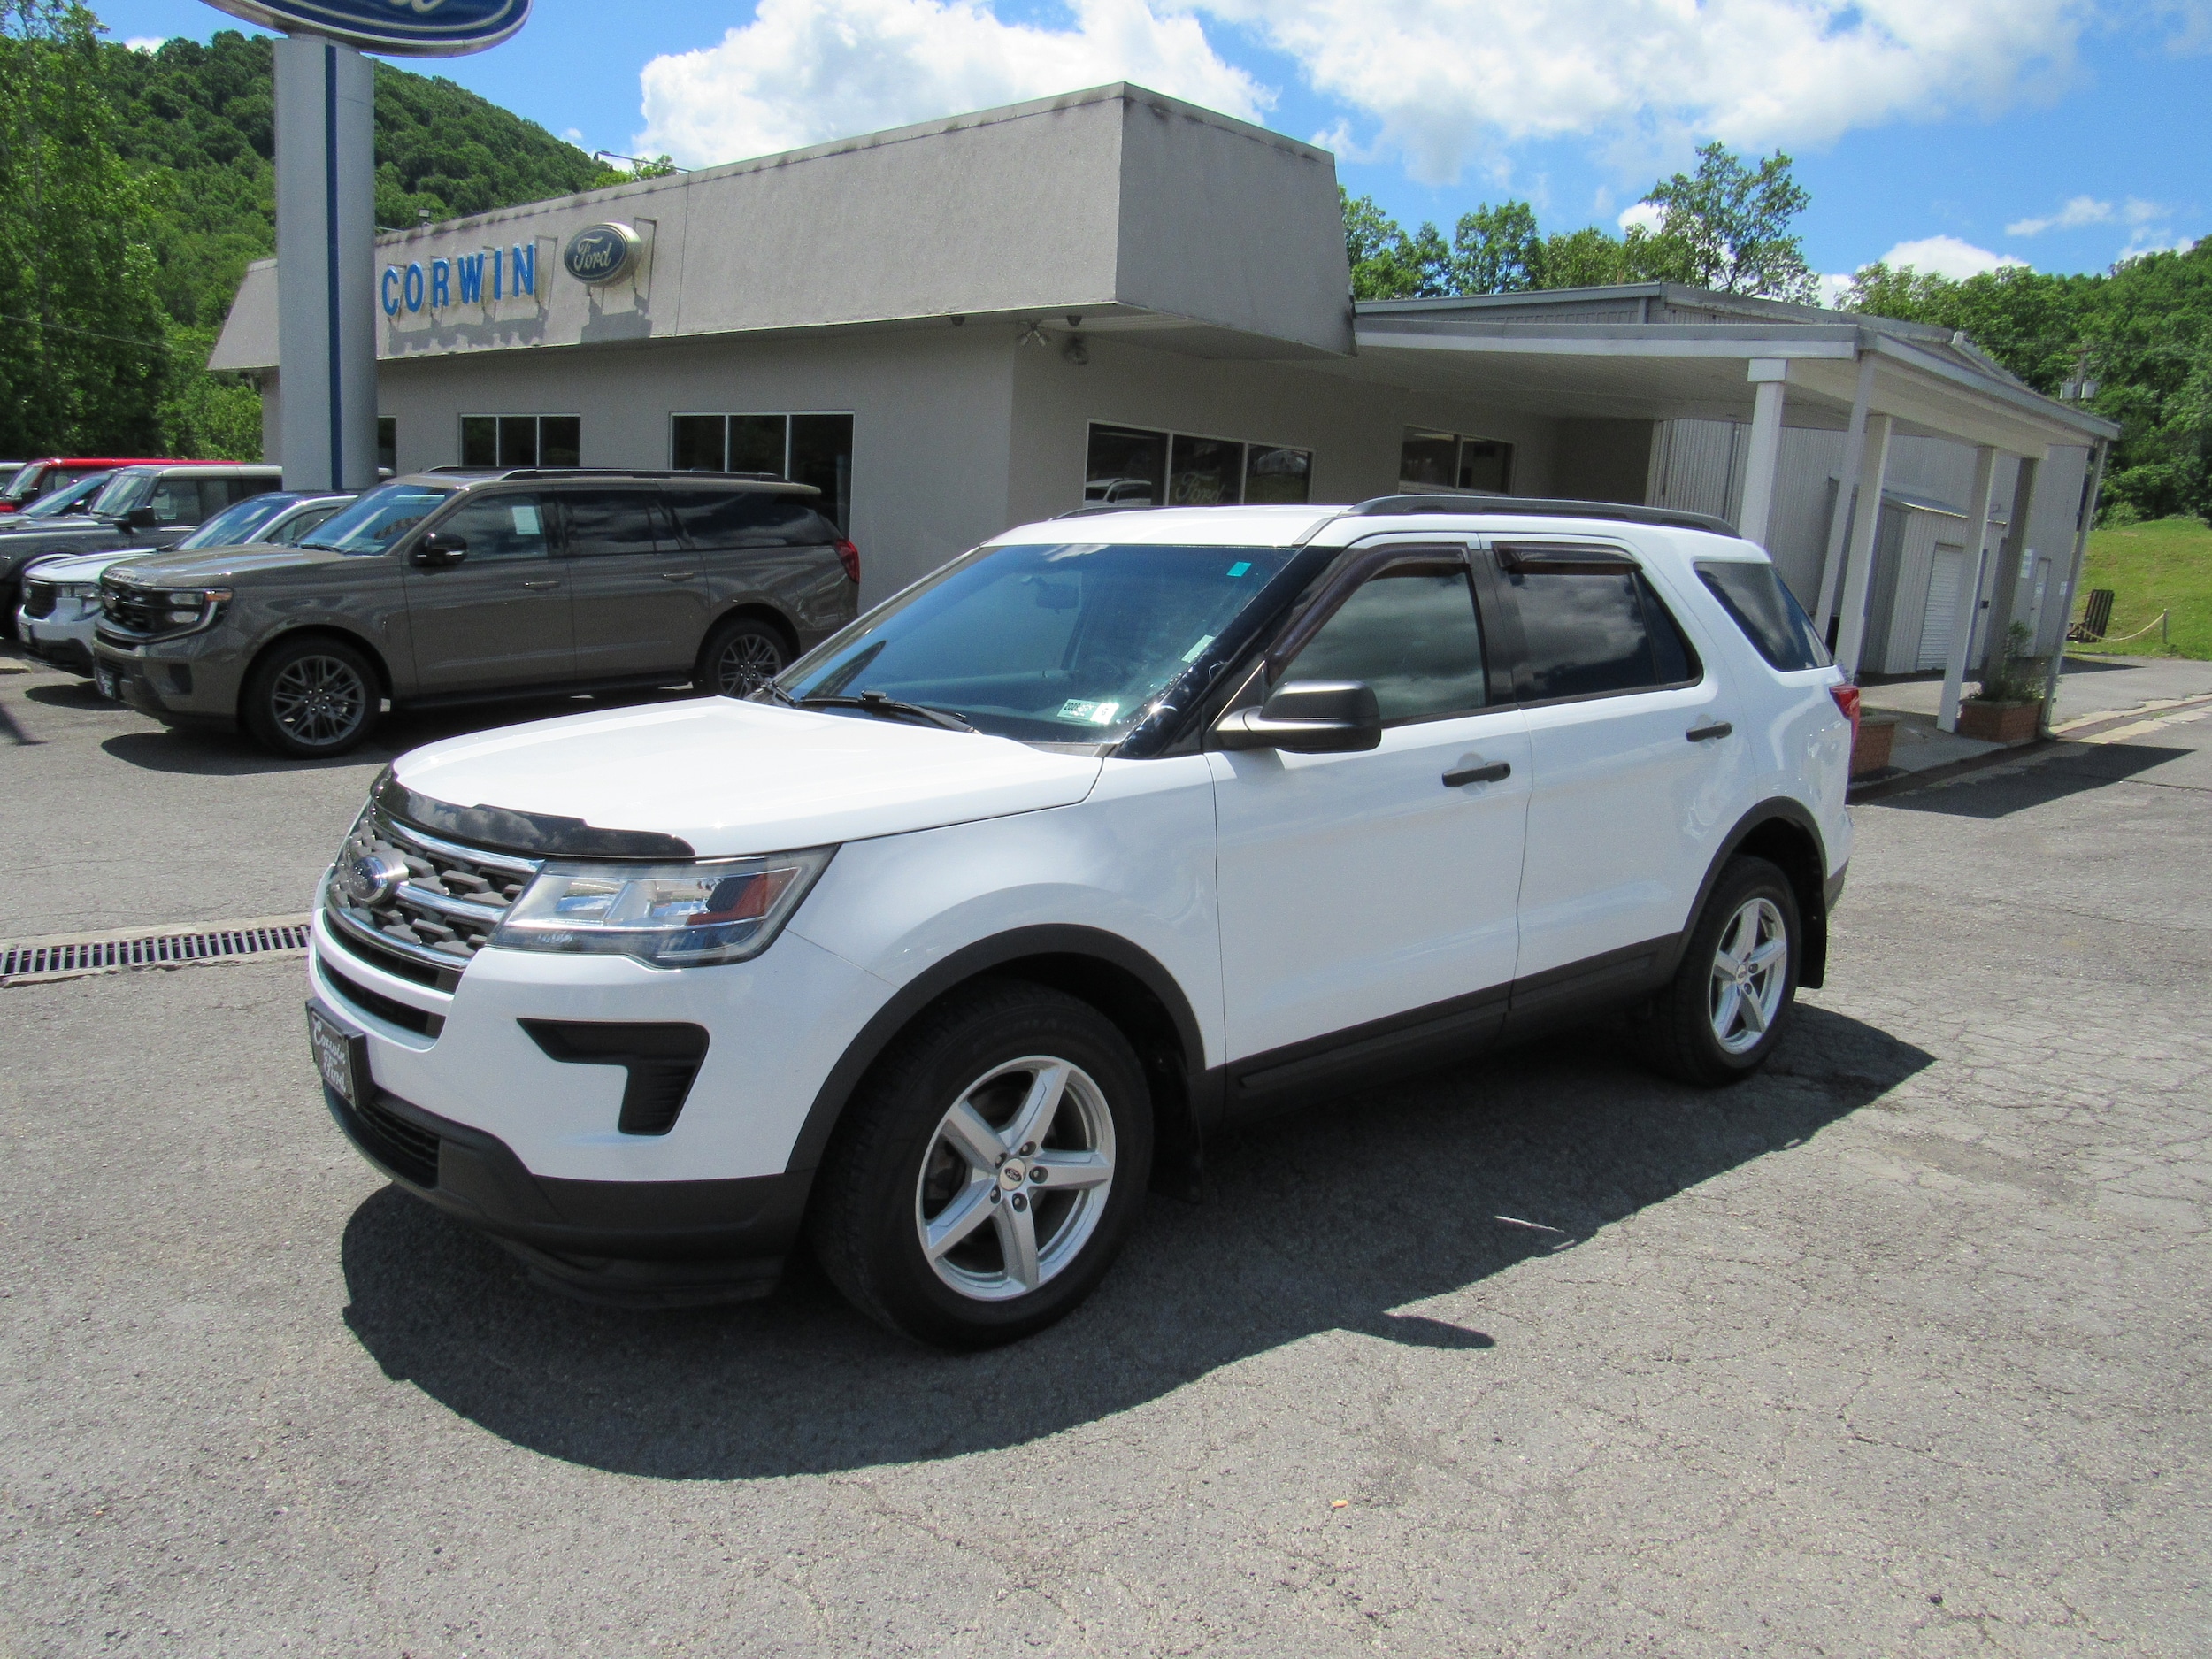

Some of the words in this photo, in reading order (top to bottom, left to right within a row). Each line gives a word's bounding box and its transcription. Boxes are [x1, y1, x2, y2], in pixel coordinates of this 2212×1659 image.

[574, 236, 612, 271] Ford
[381, 242, 535, 316] CORWIN
[1175, 471, 1225, 503] Ford
